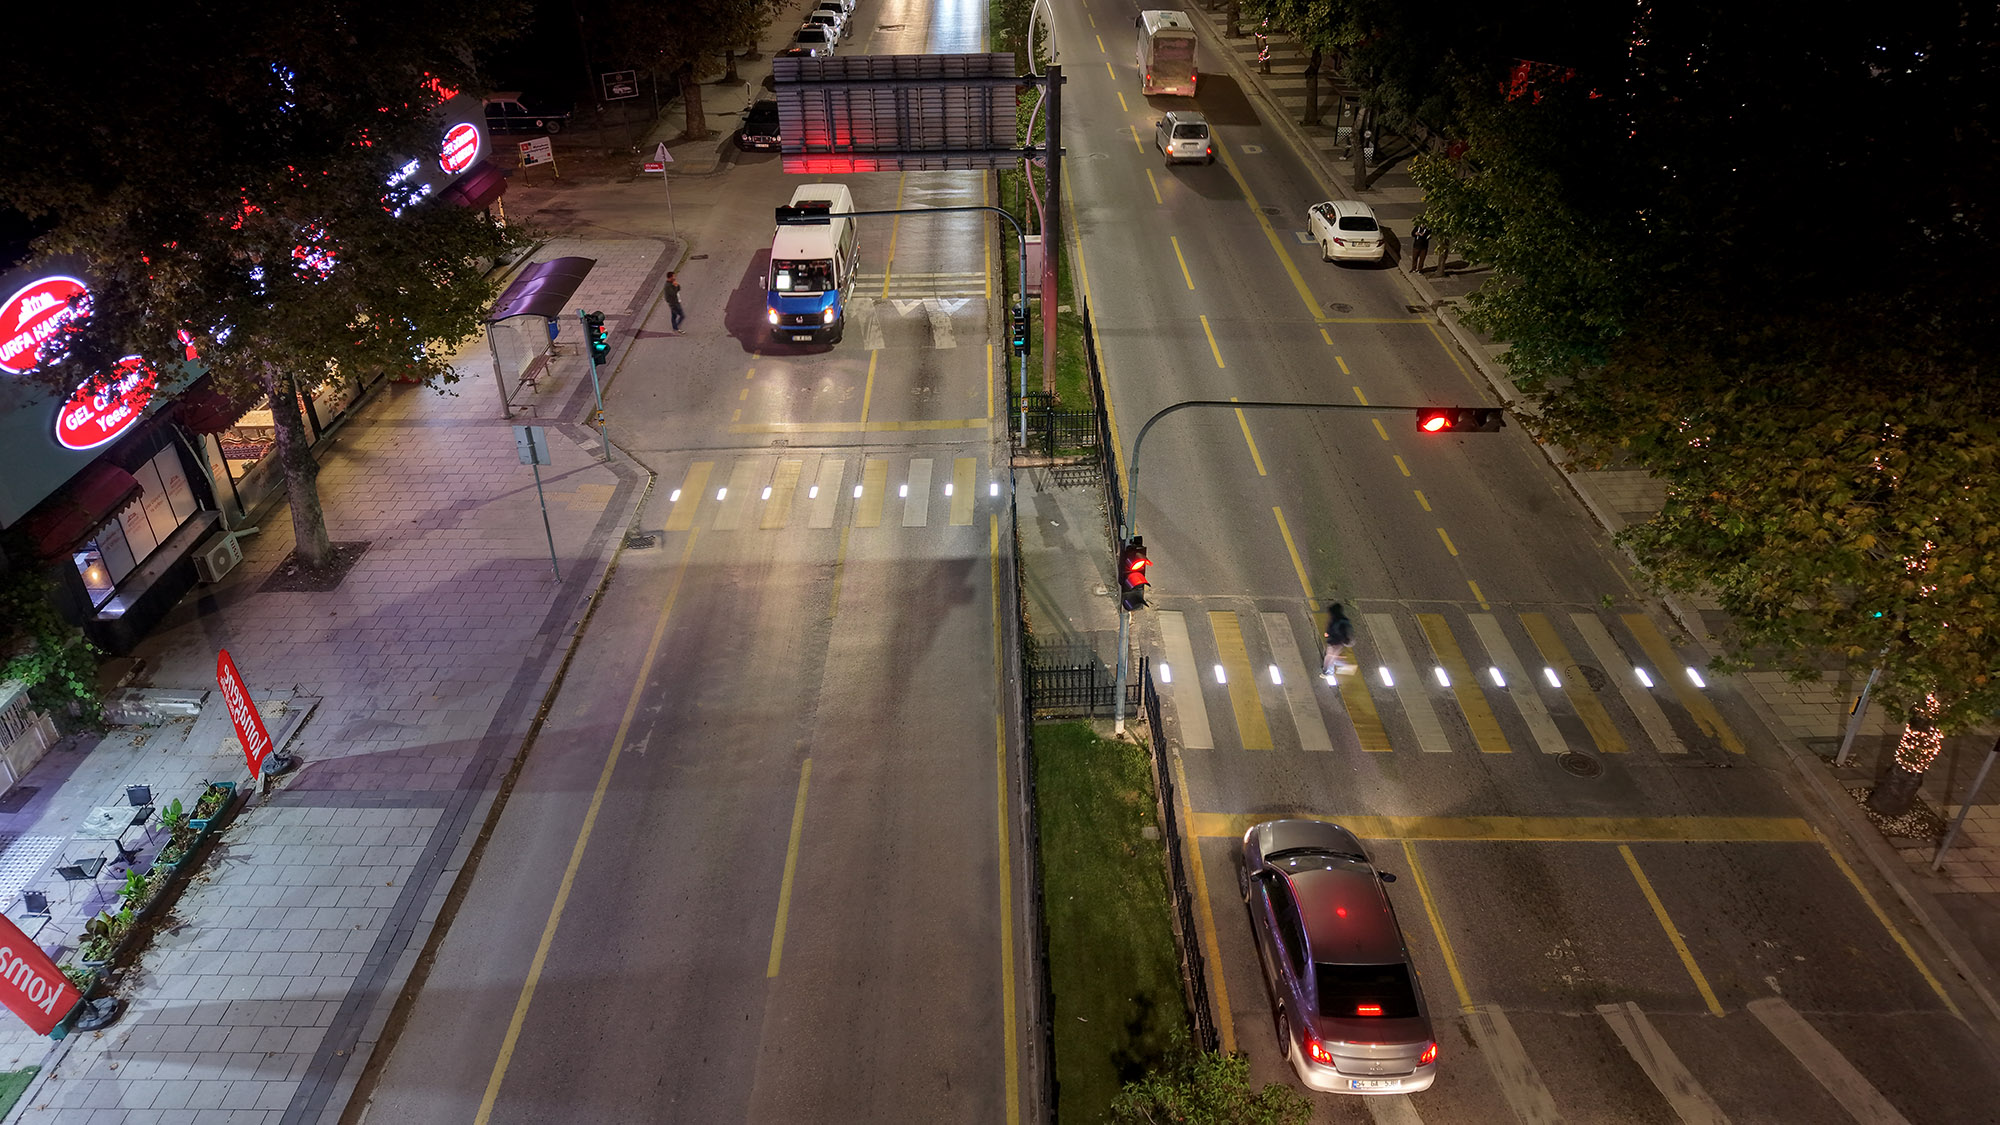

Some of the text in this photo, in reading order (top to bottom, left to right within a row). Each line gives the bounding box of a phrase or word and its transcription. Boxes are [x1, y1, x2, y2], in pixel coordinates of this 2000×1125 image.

[0, 331, 36, 361] URFA
[65, 405, 95, 431] GEL
[96, 399, 131, 432] Yeee!
